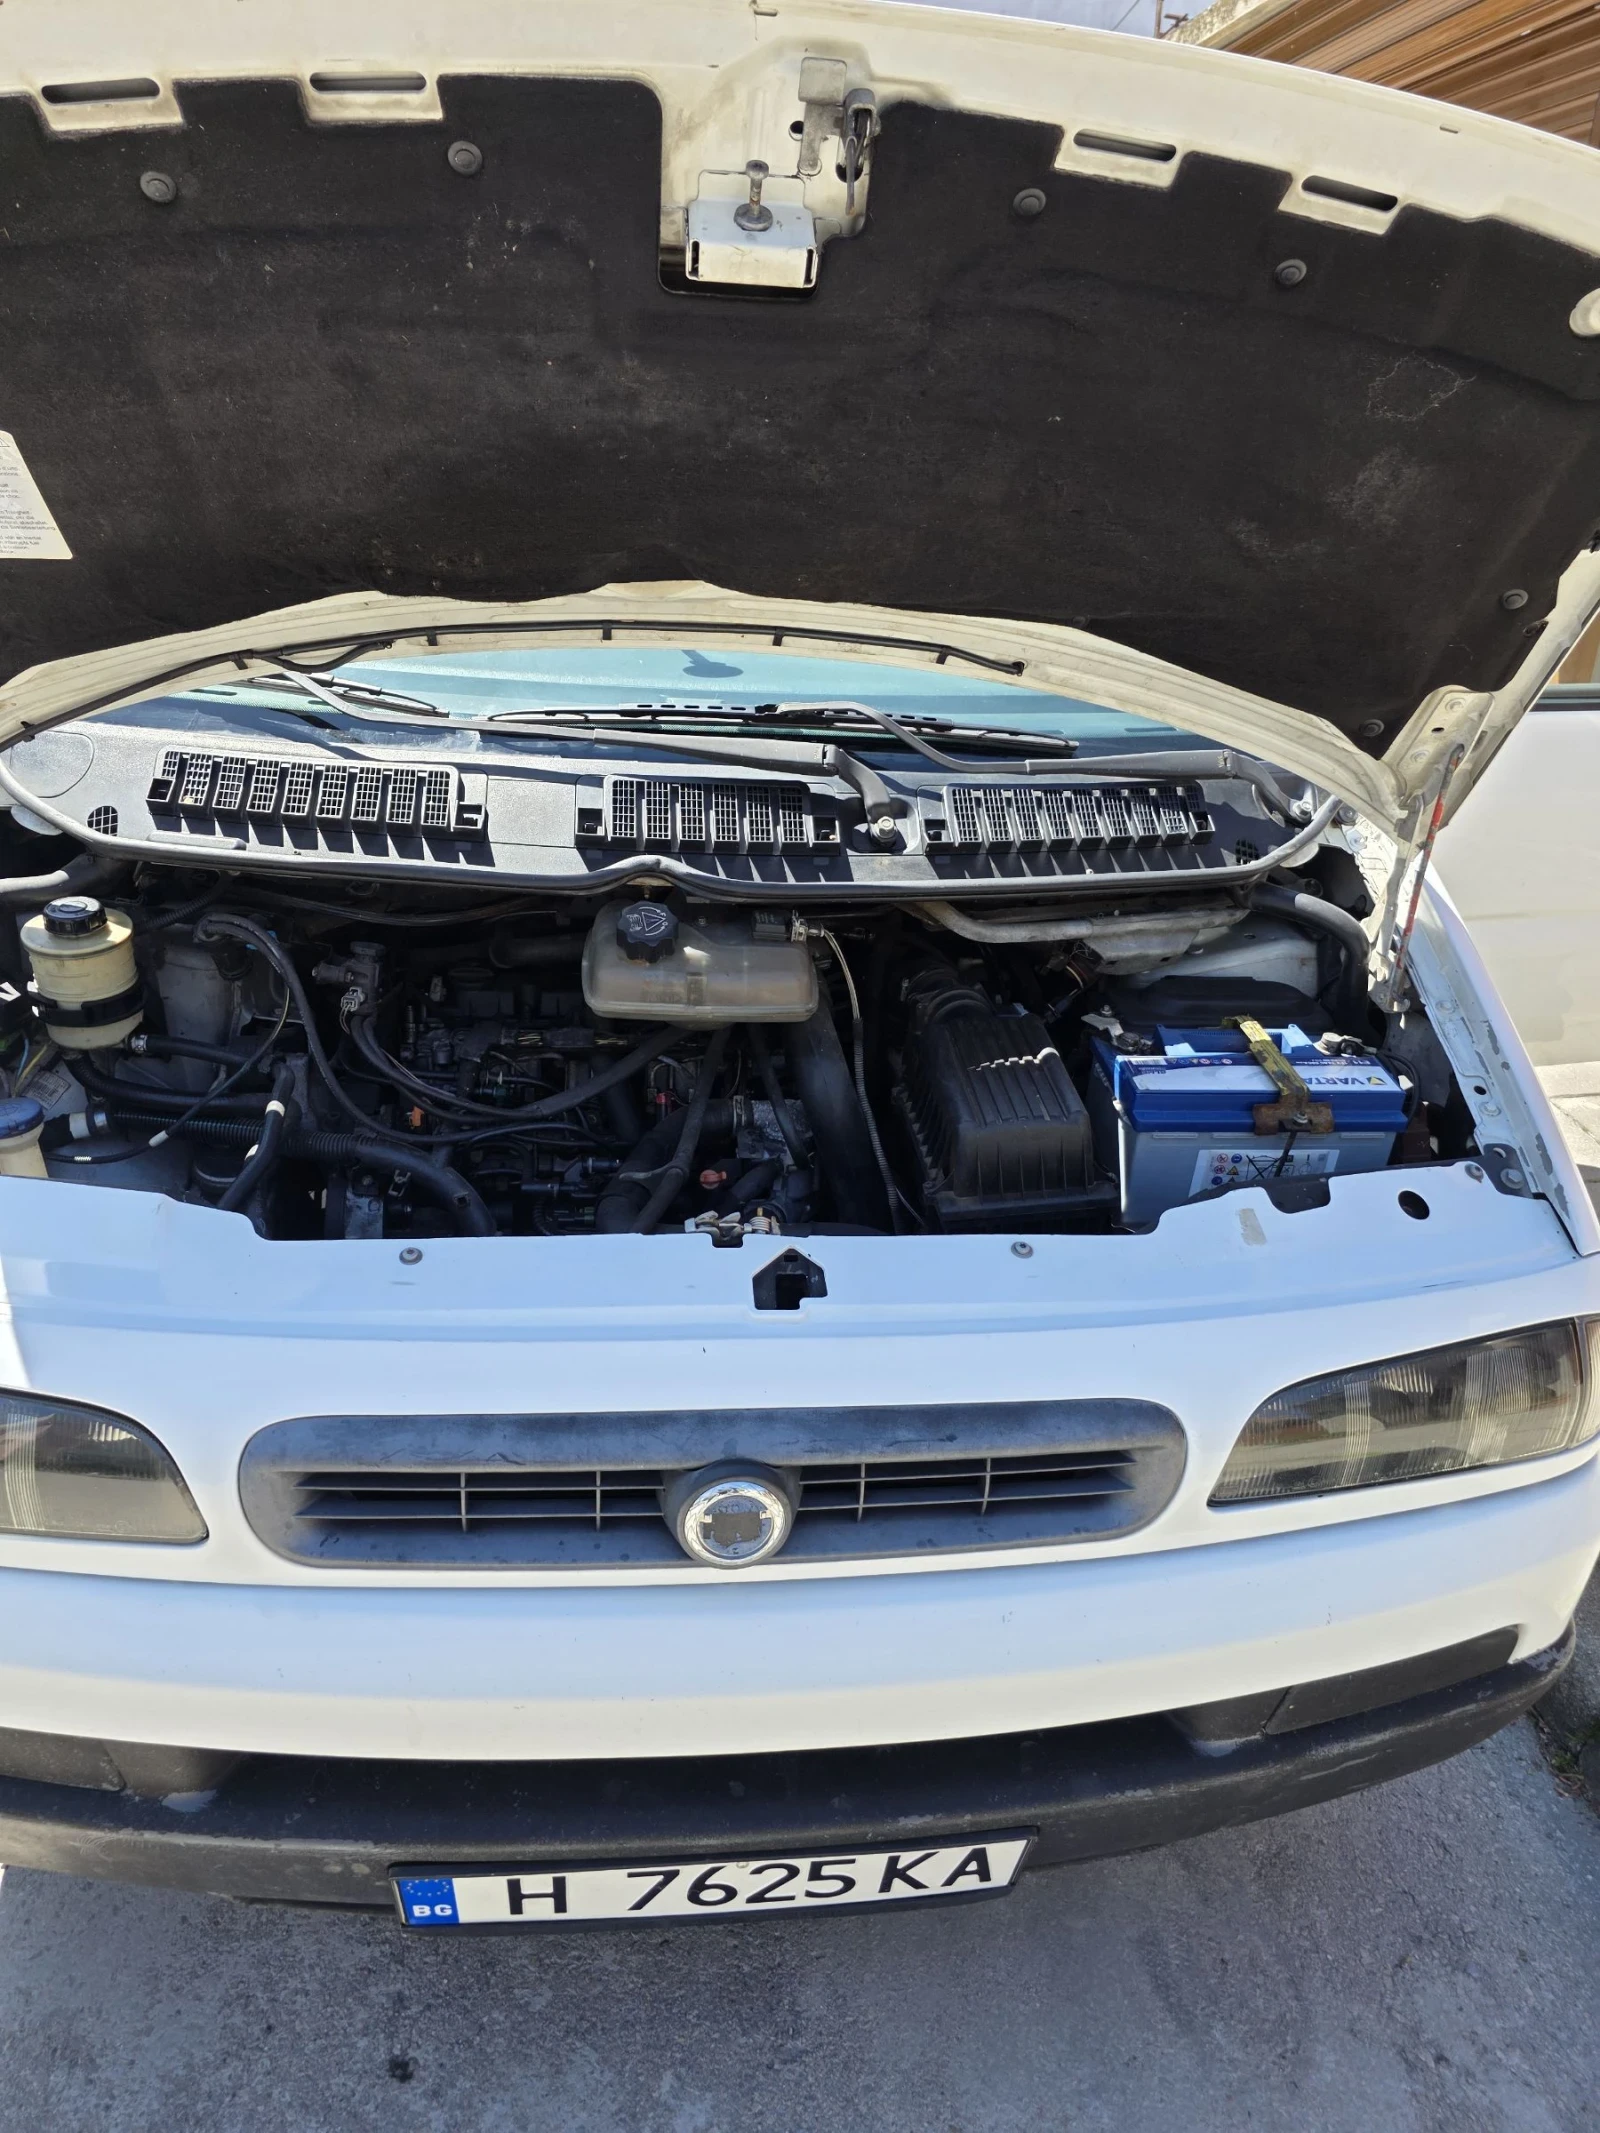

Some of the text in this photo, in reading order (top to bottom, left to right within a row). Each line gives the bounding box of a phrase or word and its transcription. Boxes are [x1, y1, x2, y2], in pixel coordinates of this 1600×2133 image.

[1304, 1077, 1366, 1085] VARTA
[507, 1847, 992, 1915] H 7625 KA
[412, 1904, 453, 1917] BG
